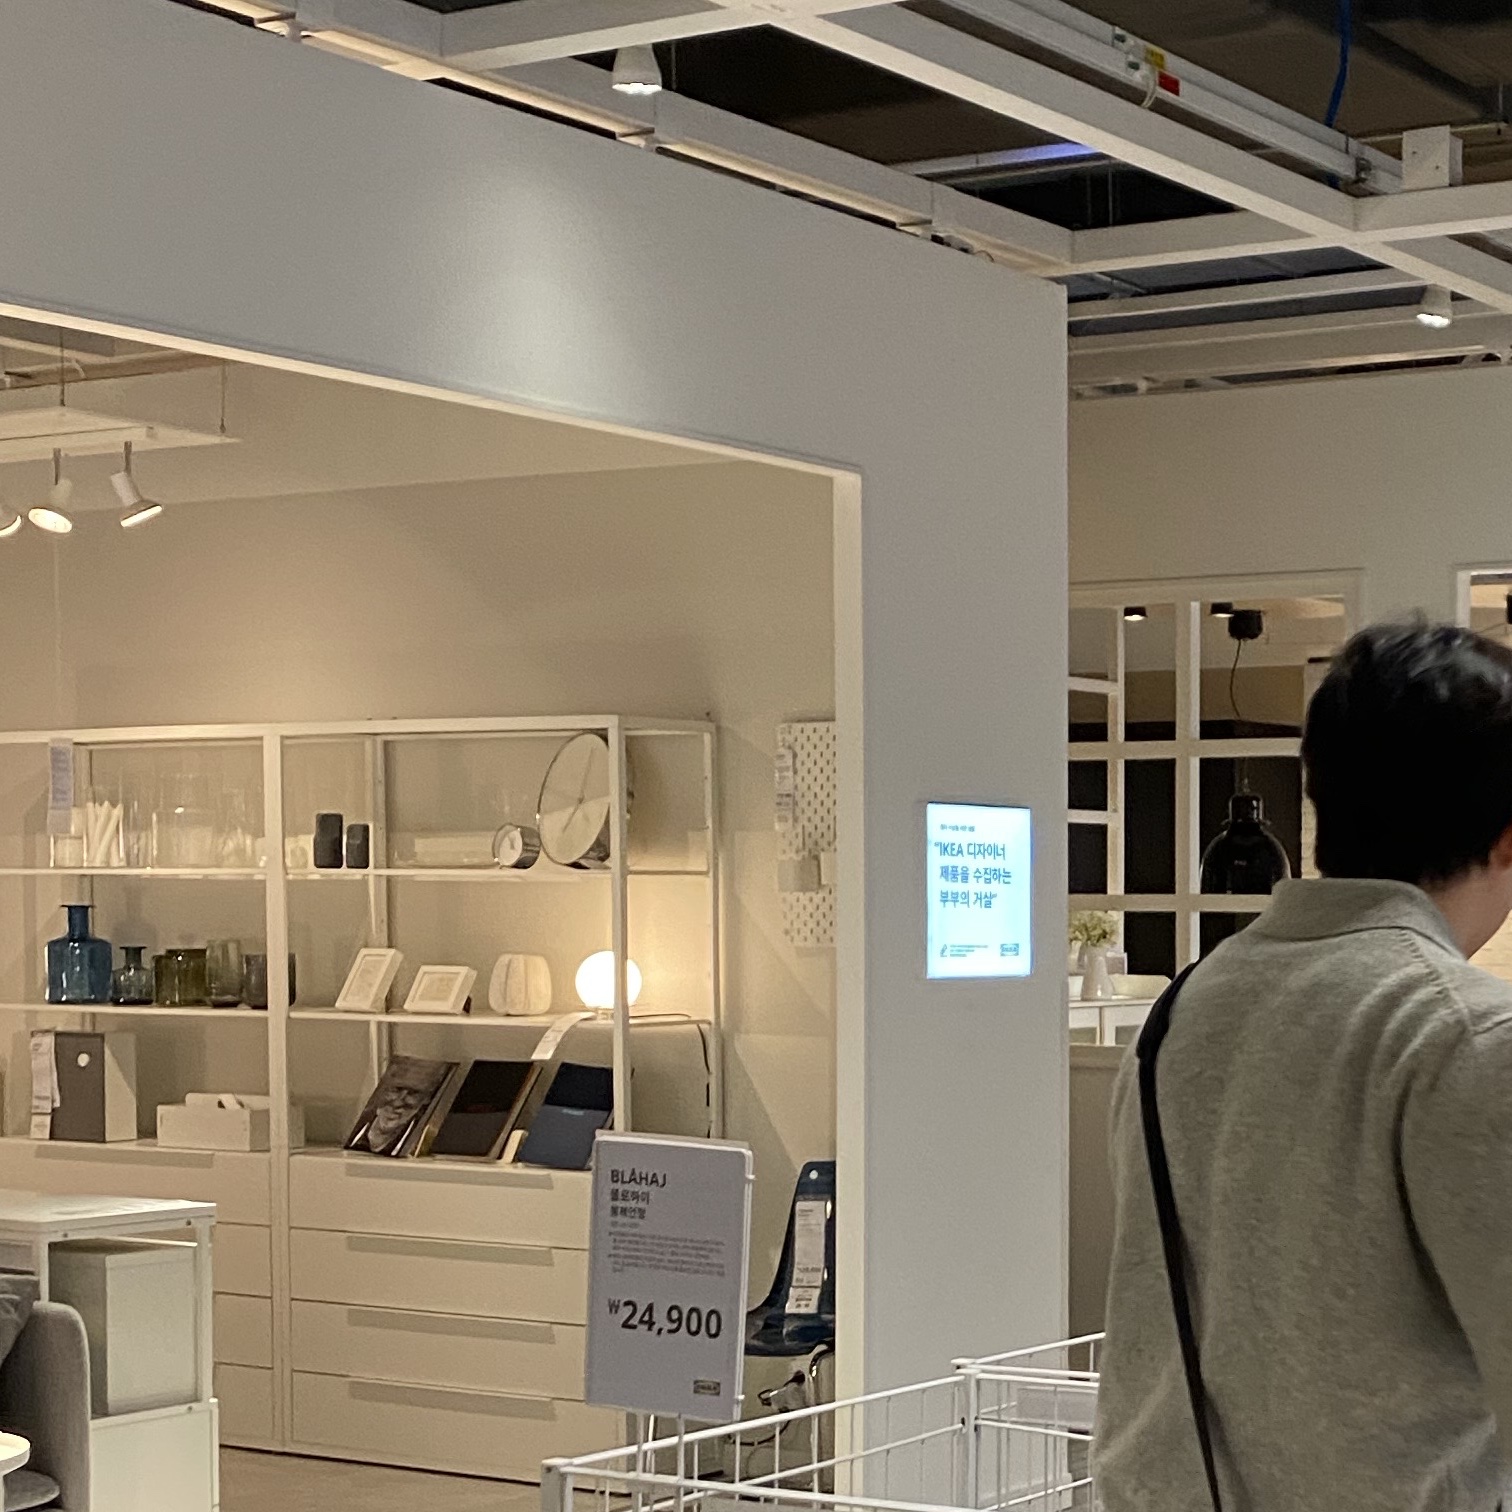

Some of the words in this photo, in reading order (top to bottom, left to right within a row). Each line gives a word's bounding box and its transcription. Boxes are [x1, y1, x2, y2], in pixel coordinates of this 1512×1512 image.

[967, 842, 1005, 860] 디자이너
[940, 865, 969, 883] 제품을
[973, 867, 1012, 884] 수집하는
[940, 890, 970, 908] 부부의
[611, 1168, 666, 1188] BLÅHAJ
